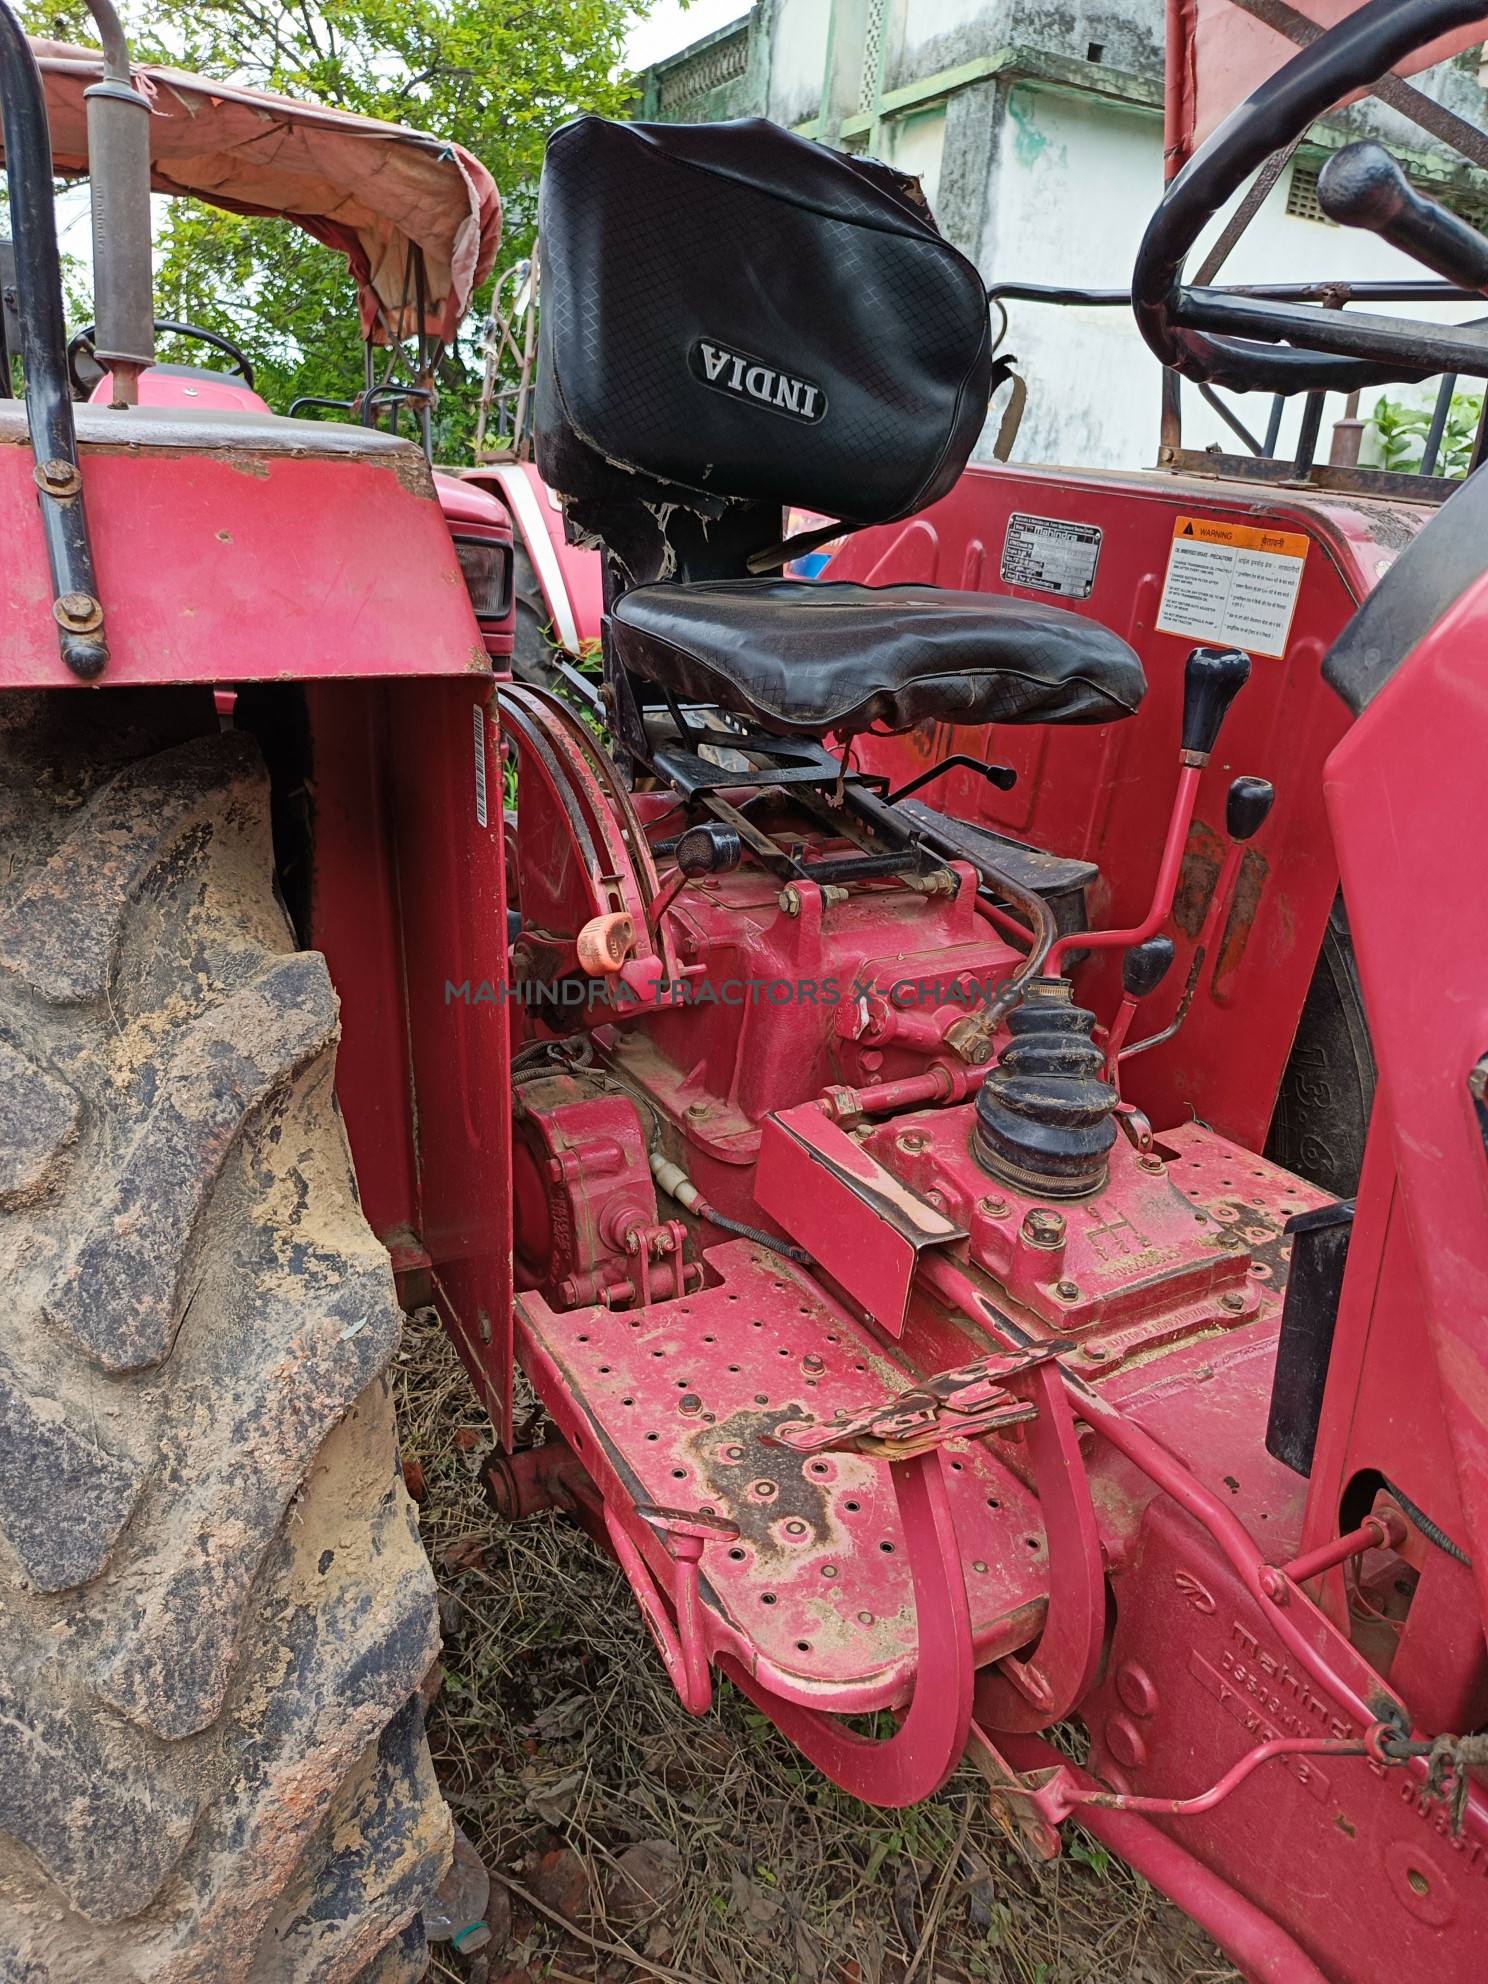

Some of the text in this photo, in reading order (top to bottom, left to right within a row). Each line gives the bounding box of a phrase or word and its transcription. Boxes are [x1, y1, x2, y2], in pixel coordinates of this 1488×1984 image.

[700, 343, 818, 418] INDIA
[1199, 528, 1232, 540] WARNING
[1209, 553, 1233, 562] PRECAUTIONS
